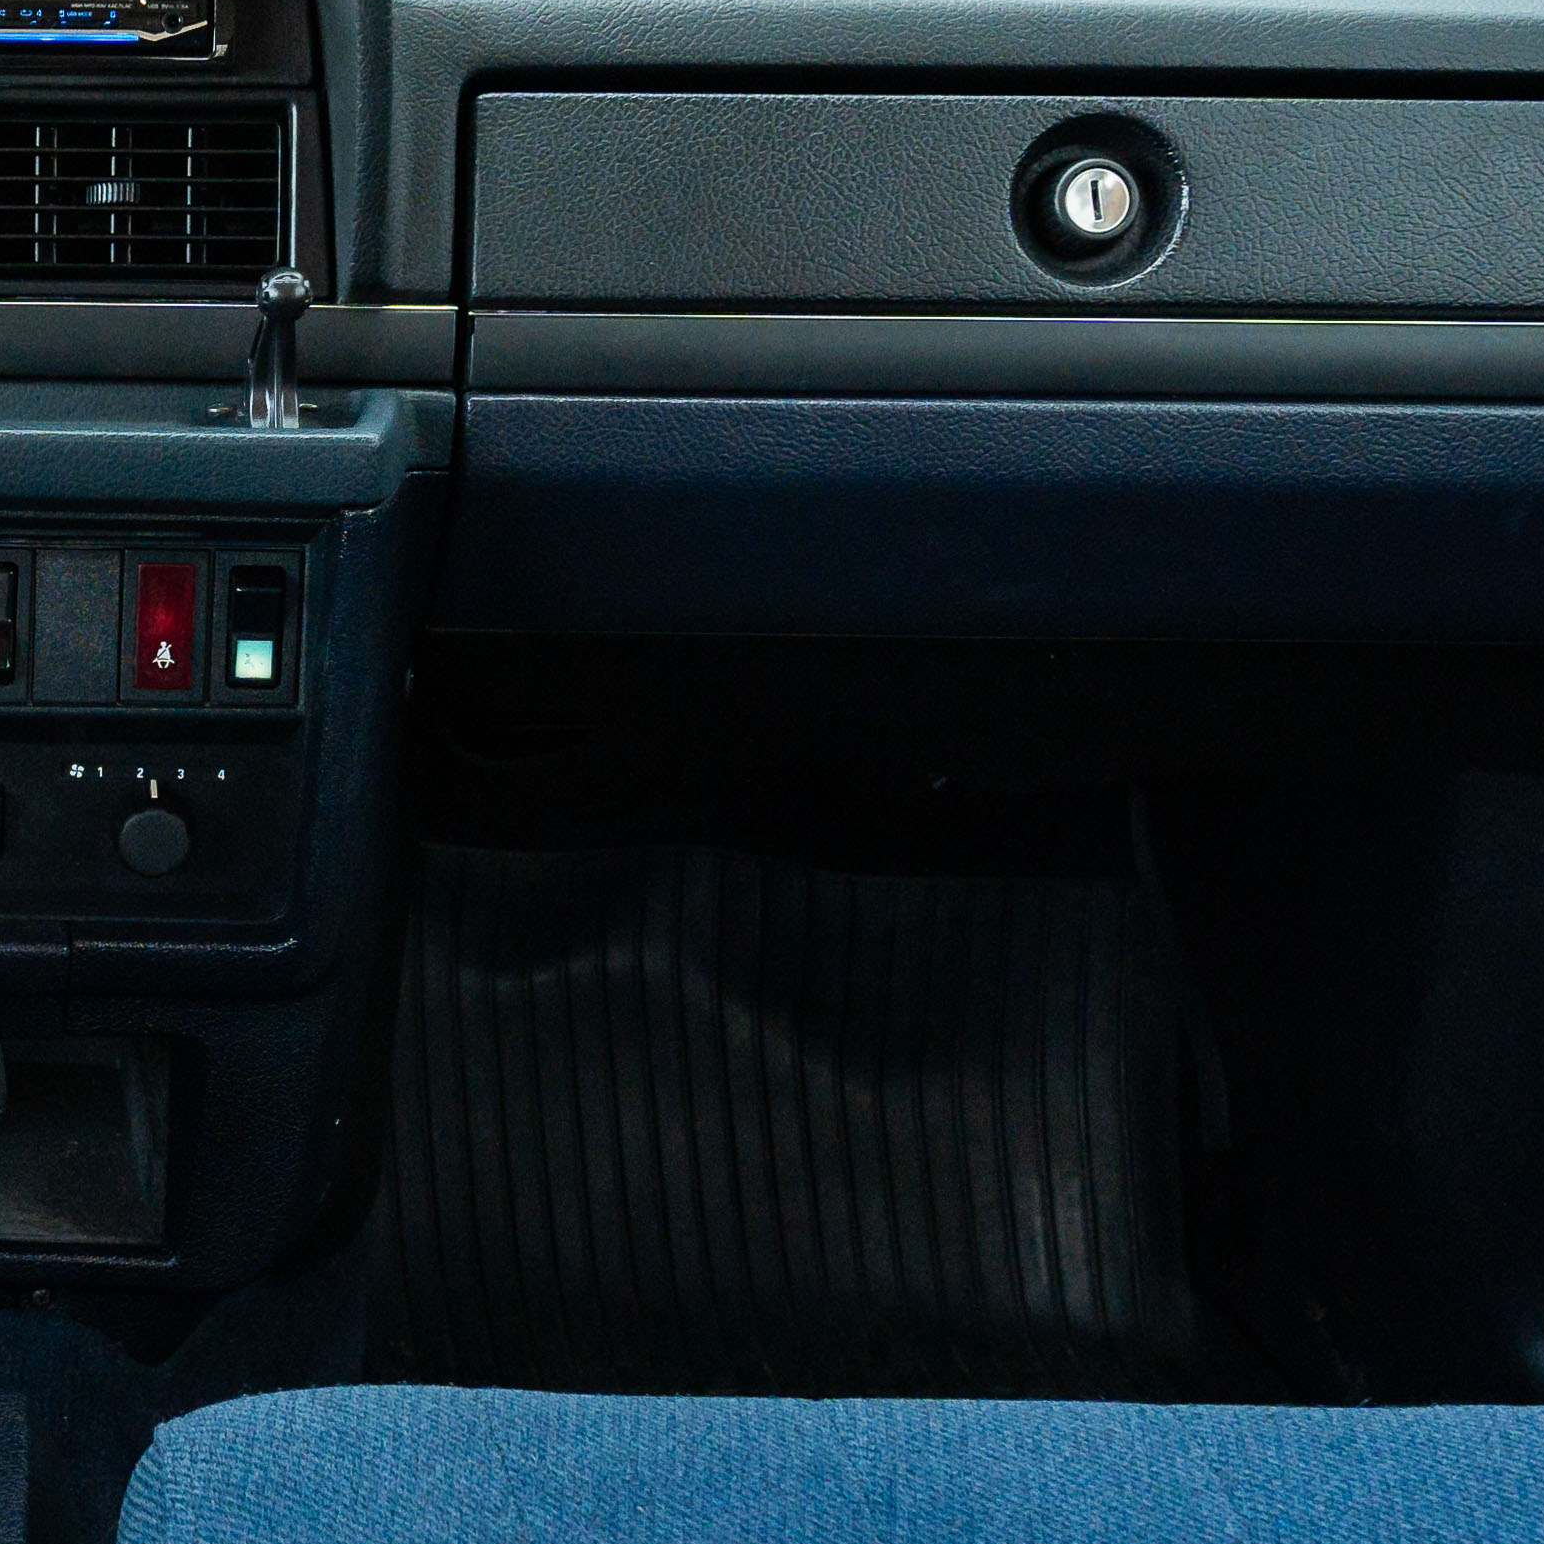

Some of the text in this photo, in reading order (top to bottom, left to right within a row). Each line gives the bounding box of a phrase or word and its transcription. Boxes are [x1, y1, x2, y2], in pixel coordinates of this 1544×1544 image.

[97, 766, 226, 781] 1 2 3 4
